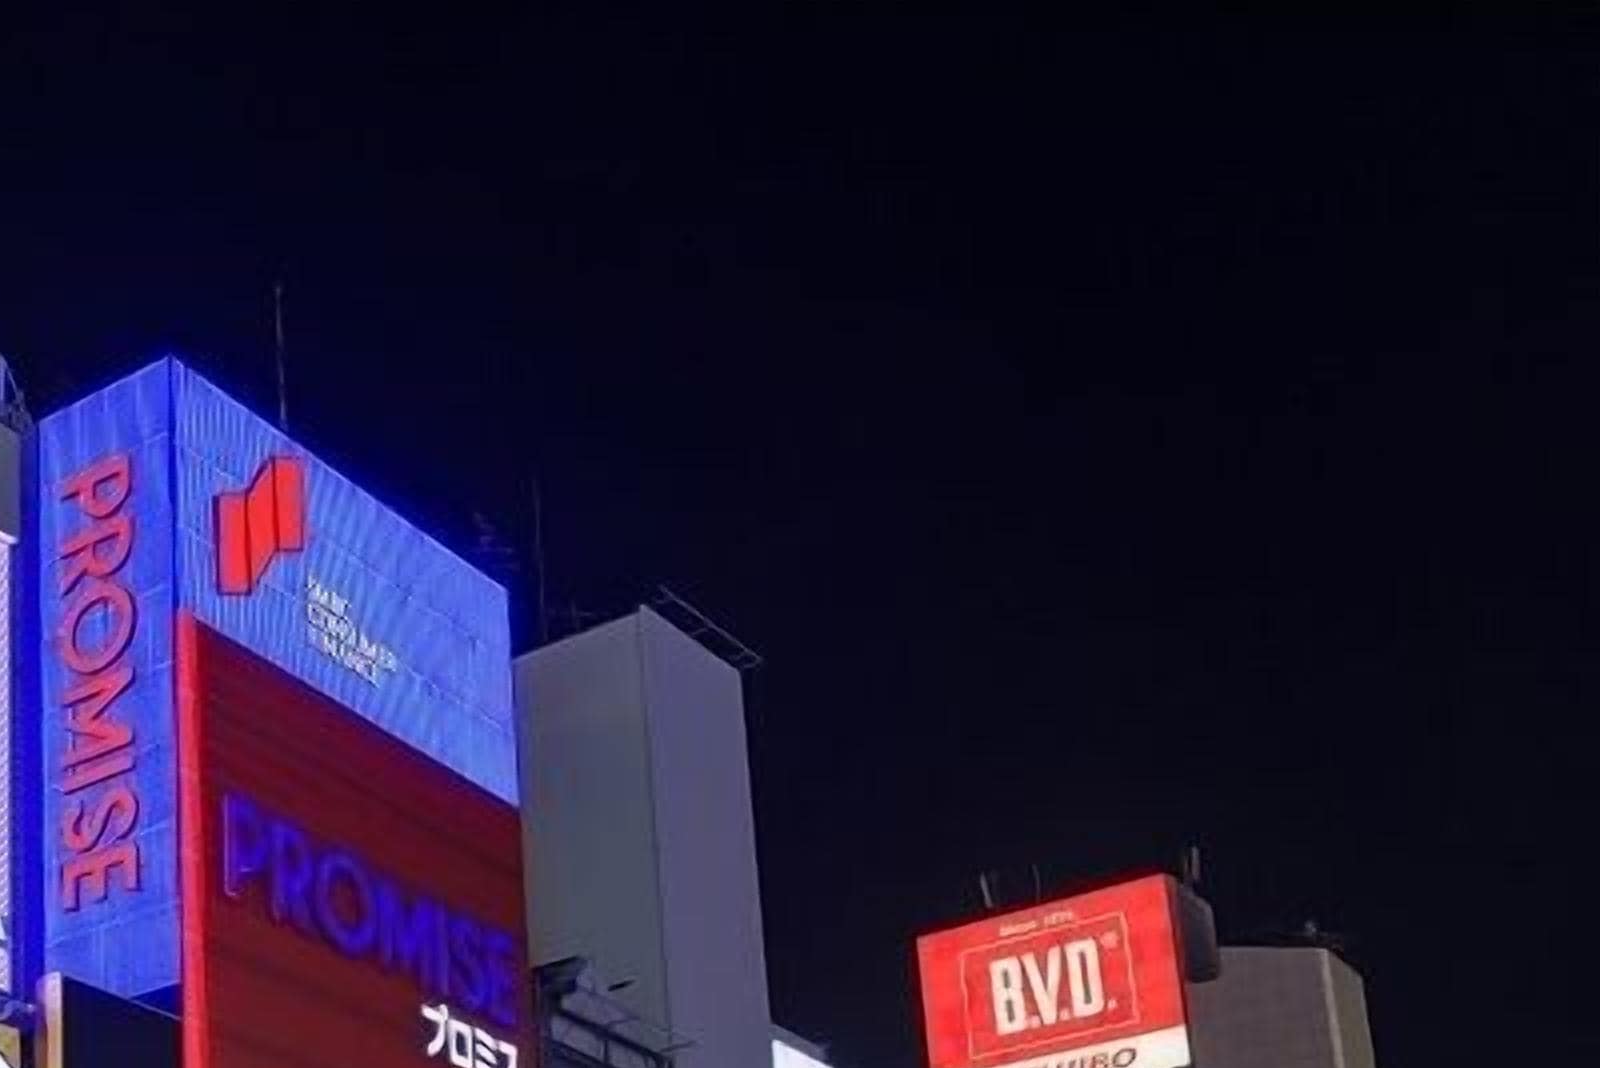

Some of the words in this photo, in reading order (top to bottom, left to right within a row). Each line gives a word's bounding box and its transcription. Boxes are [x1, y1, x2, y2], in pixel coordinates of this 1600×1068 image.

[60, 452, 141, 914] PROMISE
[222, 792, 517, 1030] PROMISE
[988, 936, 1119, 1037] B.V.D.
